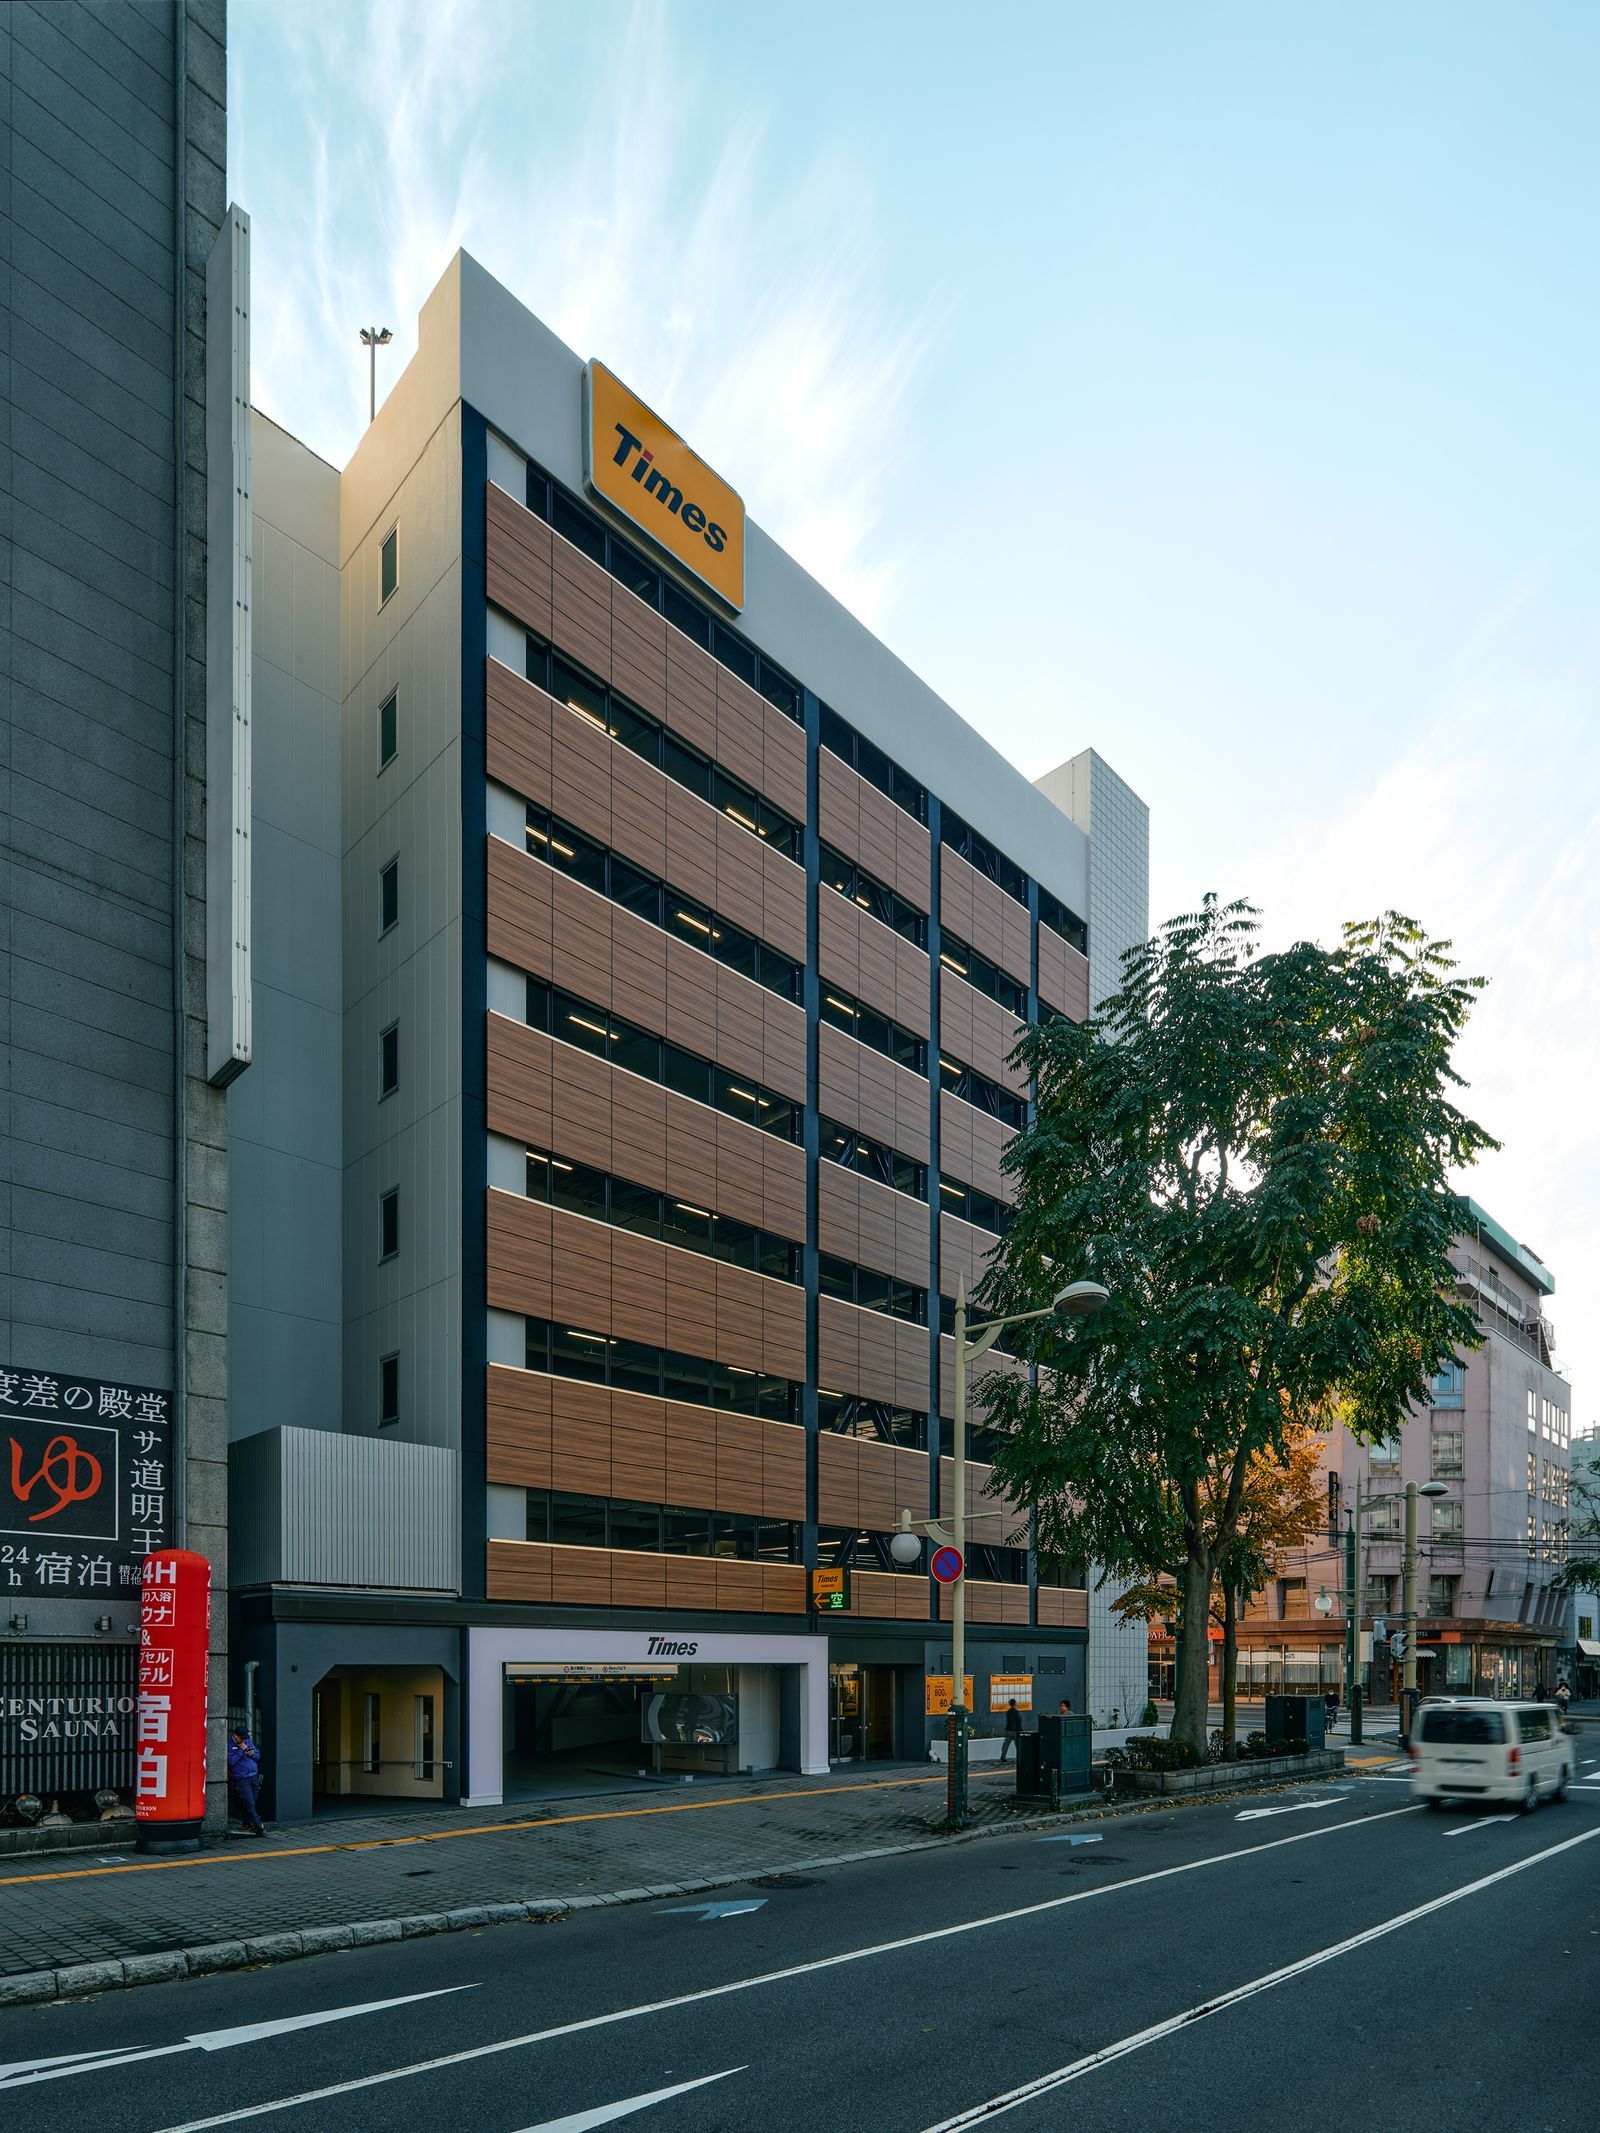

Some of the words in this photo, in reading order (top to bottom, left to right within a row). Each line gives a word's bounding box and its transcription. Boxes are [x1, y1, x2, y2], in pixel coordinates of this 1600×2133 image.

[613, 422, 727, 553] Times
[9, 1435, 102, 1522] ゆ
[130, 1431, 165, 1555] サ道明王
[1, 1546, 30, 1564] 24
[35, 1551, 112, 1587] 宿泊
[818, 1575, 839, 1583] Times
[142, 1592, 172, 1603] り入浴
[831, 1592, 843, 1608] 空
[142, 1630, 152, 1646] &
[647, 1637, 699, 1656] Times
[0, 1697, 139, 1718] ENTURIO
[20, 1718, 120, 1741] SAUNA
